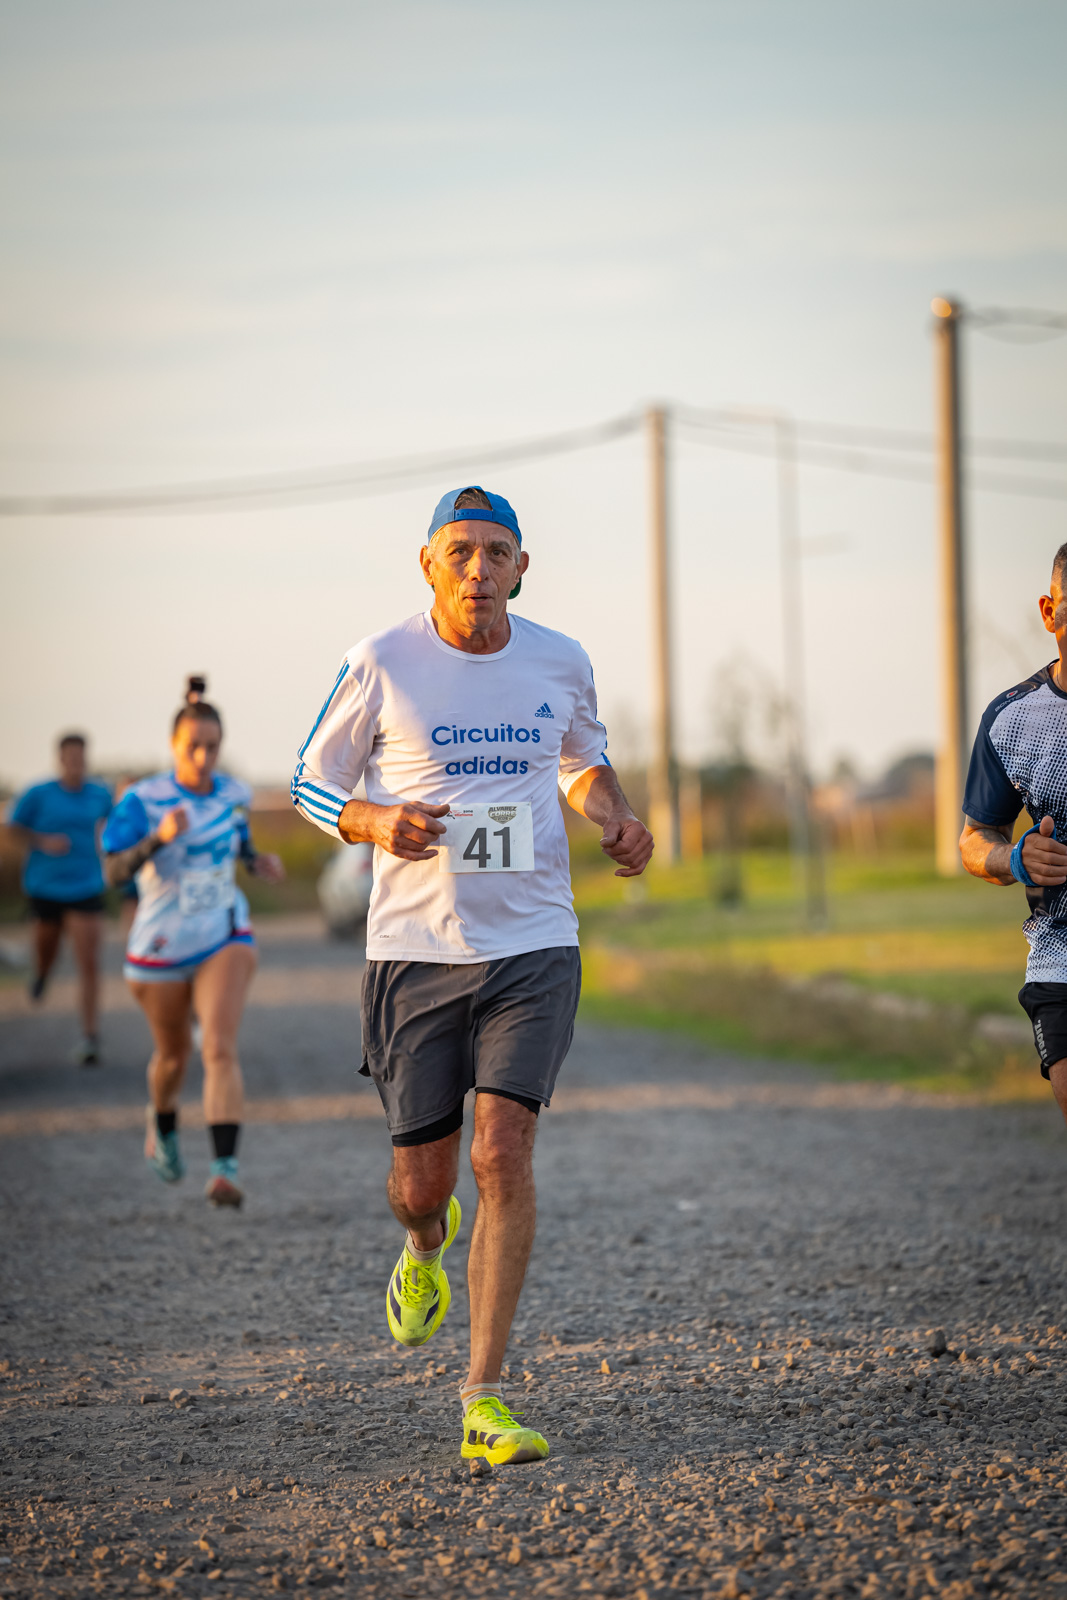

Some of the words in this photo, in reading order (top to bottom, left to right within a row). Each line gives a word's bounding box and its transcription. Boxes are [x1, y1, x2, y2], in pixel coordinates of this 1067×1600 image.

[431, 723, 541, 746] Circuitos
[445, 756, 529, 776] adidas
[463, 827, 511, 868] 41
